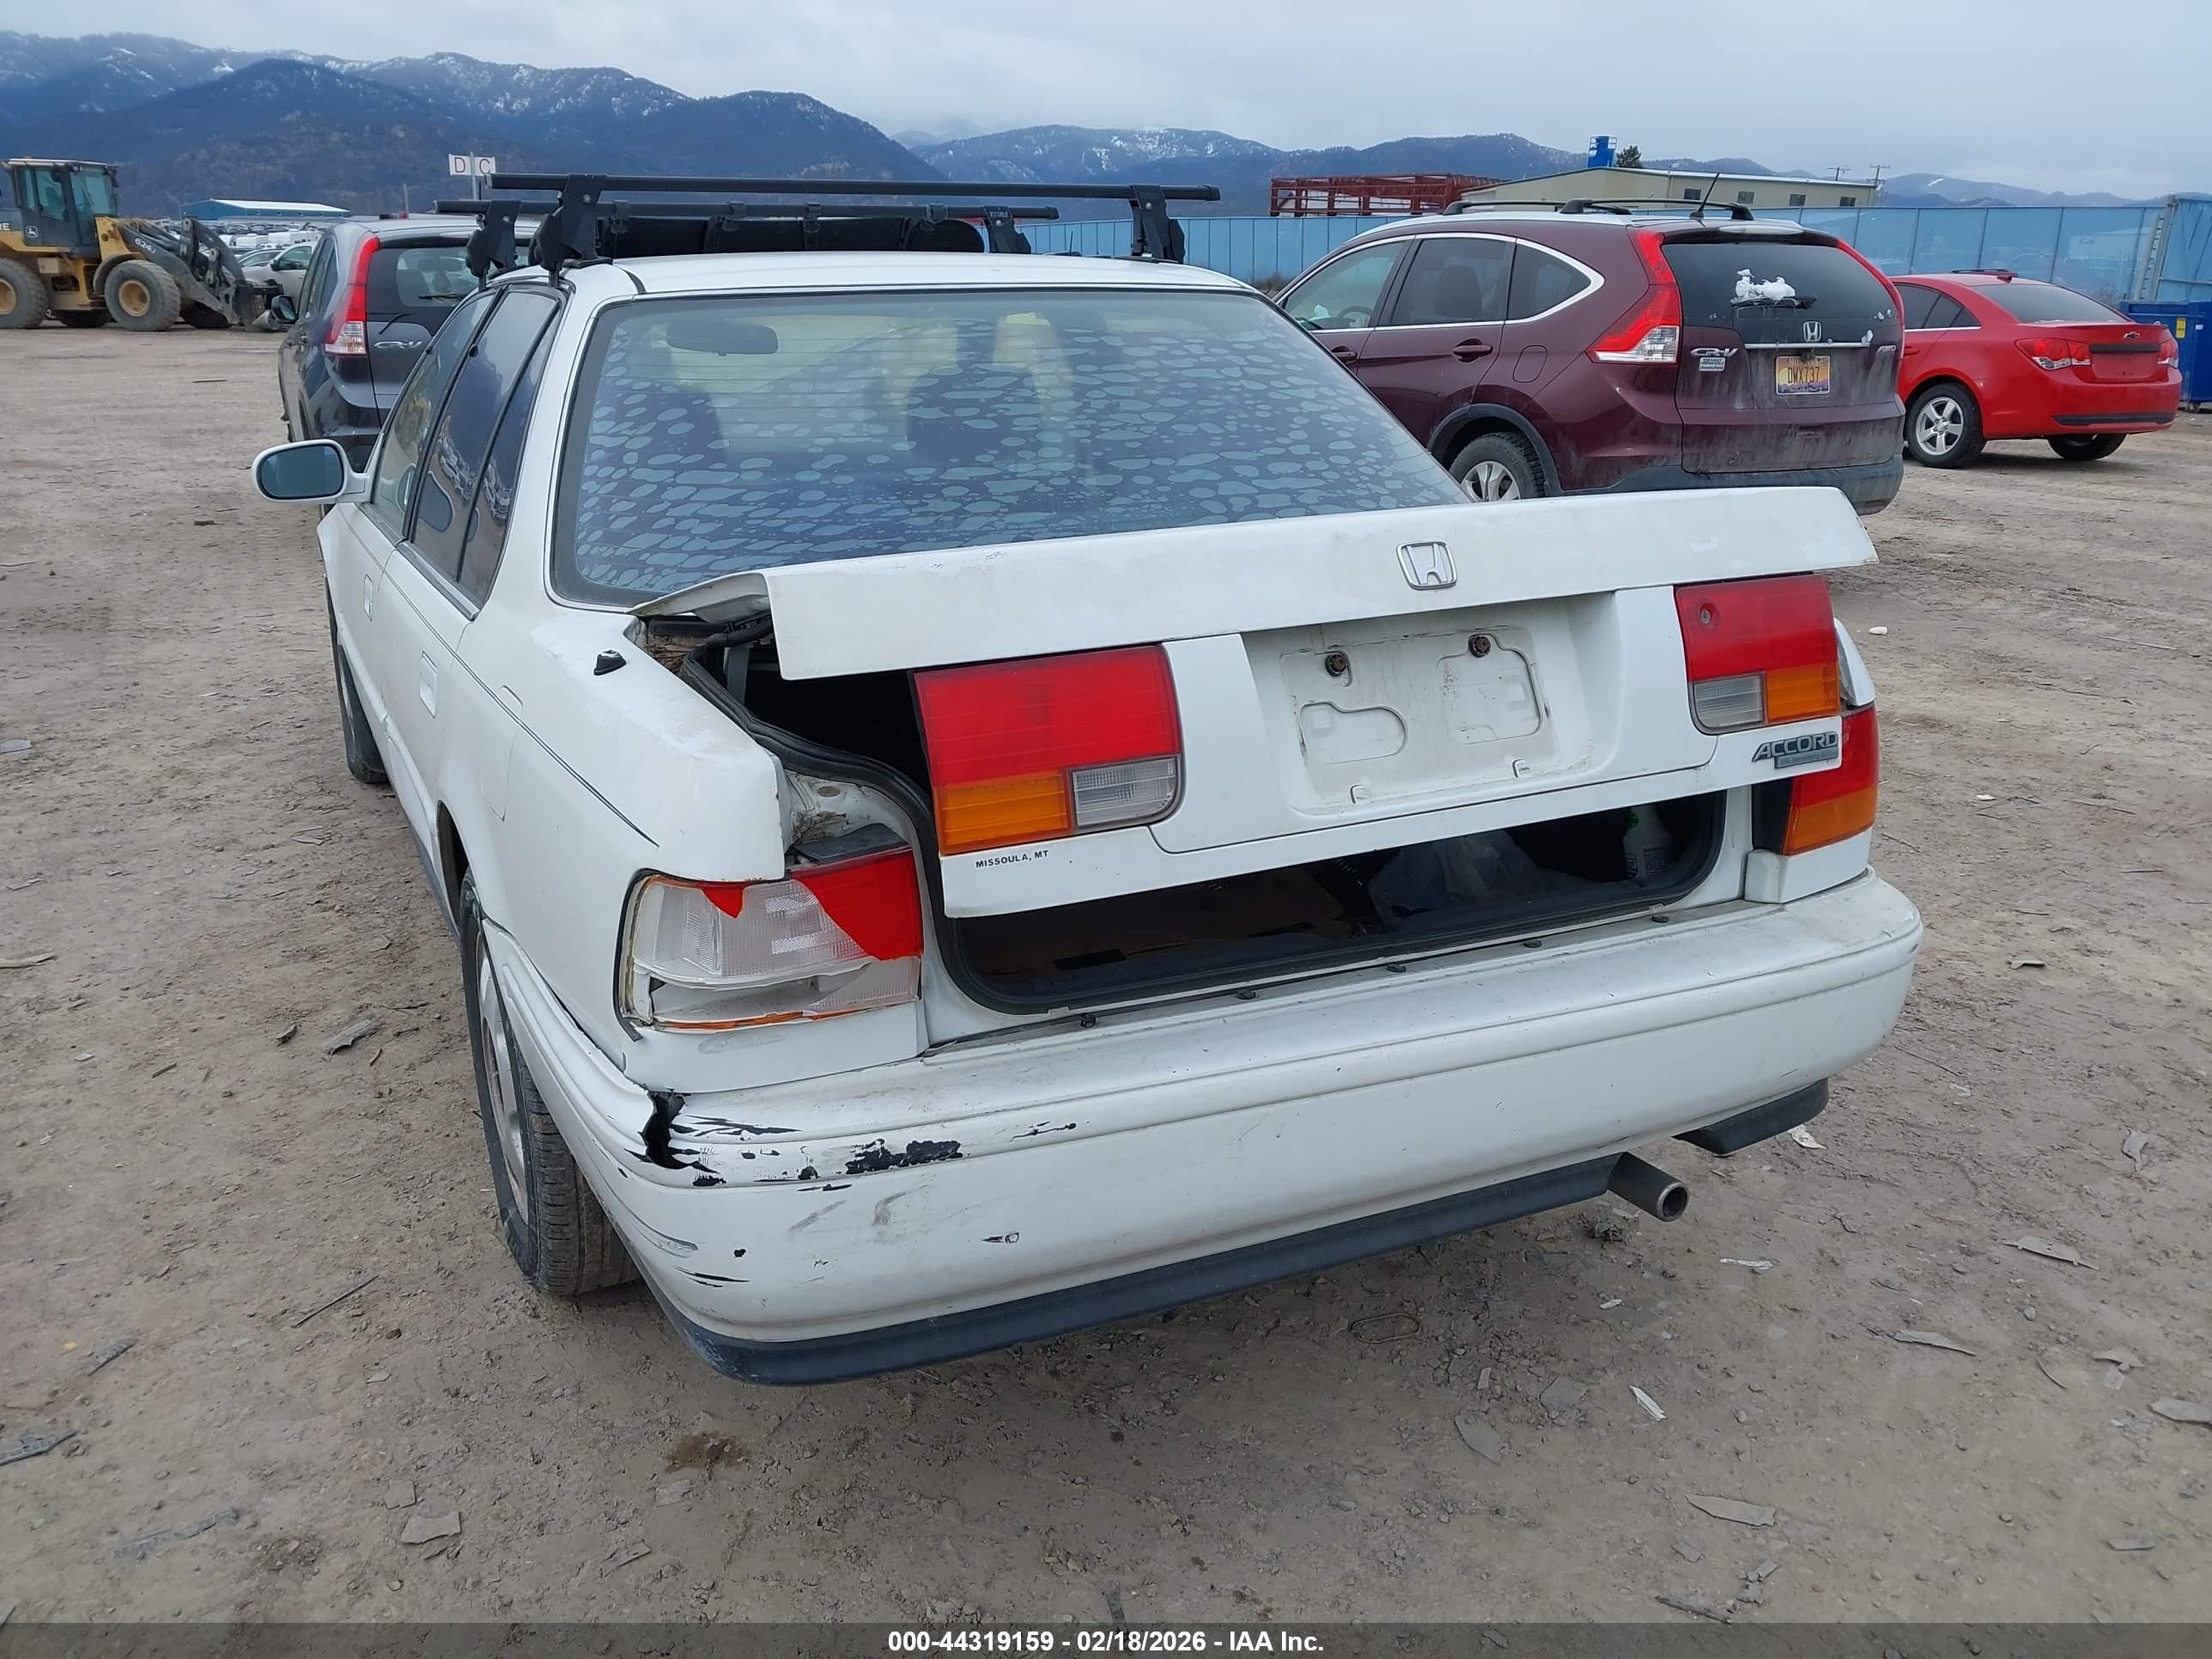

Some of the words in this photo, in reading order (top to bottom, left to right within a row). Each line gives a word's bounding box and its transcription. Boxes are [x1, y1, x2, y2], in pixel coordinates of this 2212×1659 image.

[454, 156, 466, 173] D
[479, 158, 490, 174] C
[1691, 347, 1739, 357] CR-V
[1752, 731, 1838, 763] ACCORD
[975, 853, 1032, 868] MISSOULA,
[1034, 849, 1049, 859] MT
